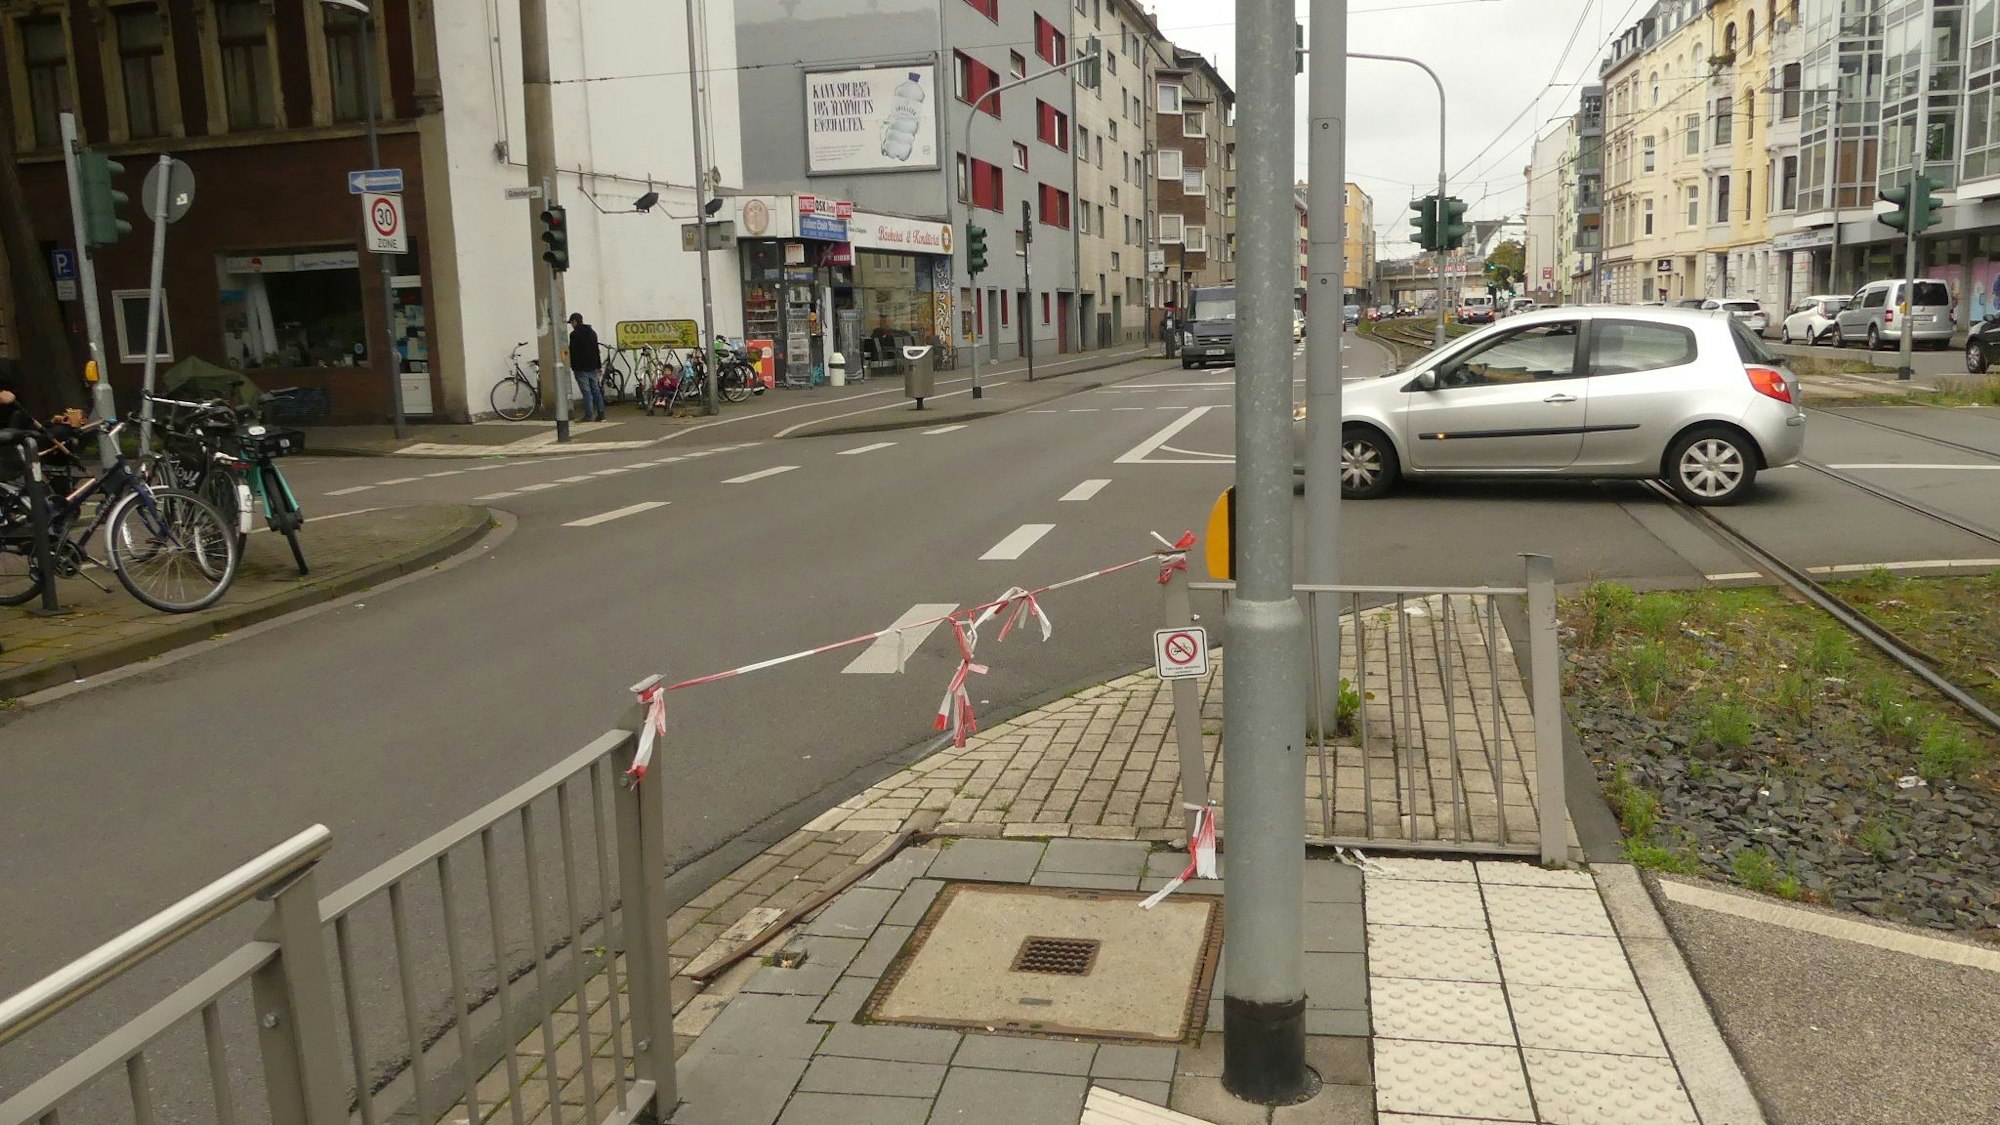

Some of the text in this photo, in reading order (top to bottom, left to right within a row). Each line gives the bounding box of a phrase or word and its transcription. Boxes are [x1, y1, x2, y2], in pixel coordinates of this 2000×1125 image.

[813, 83, 835, 99] KANN
[830, 99, 874, 116] MAMMUTS
[377, 208, 392, 226] 30
[377, 238, 397, 249] ZONE
[878, 225, 903, 243] Bäckerei
[912, 230, 940, 246] Konditorei
[623, 322, 672, 335] COSMOS
